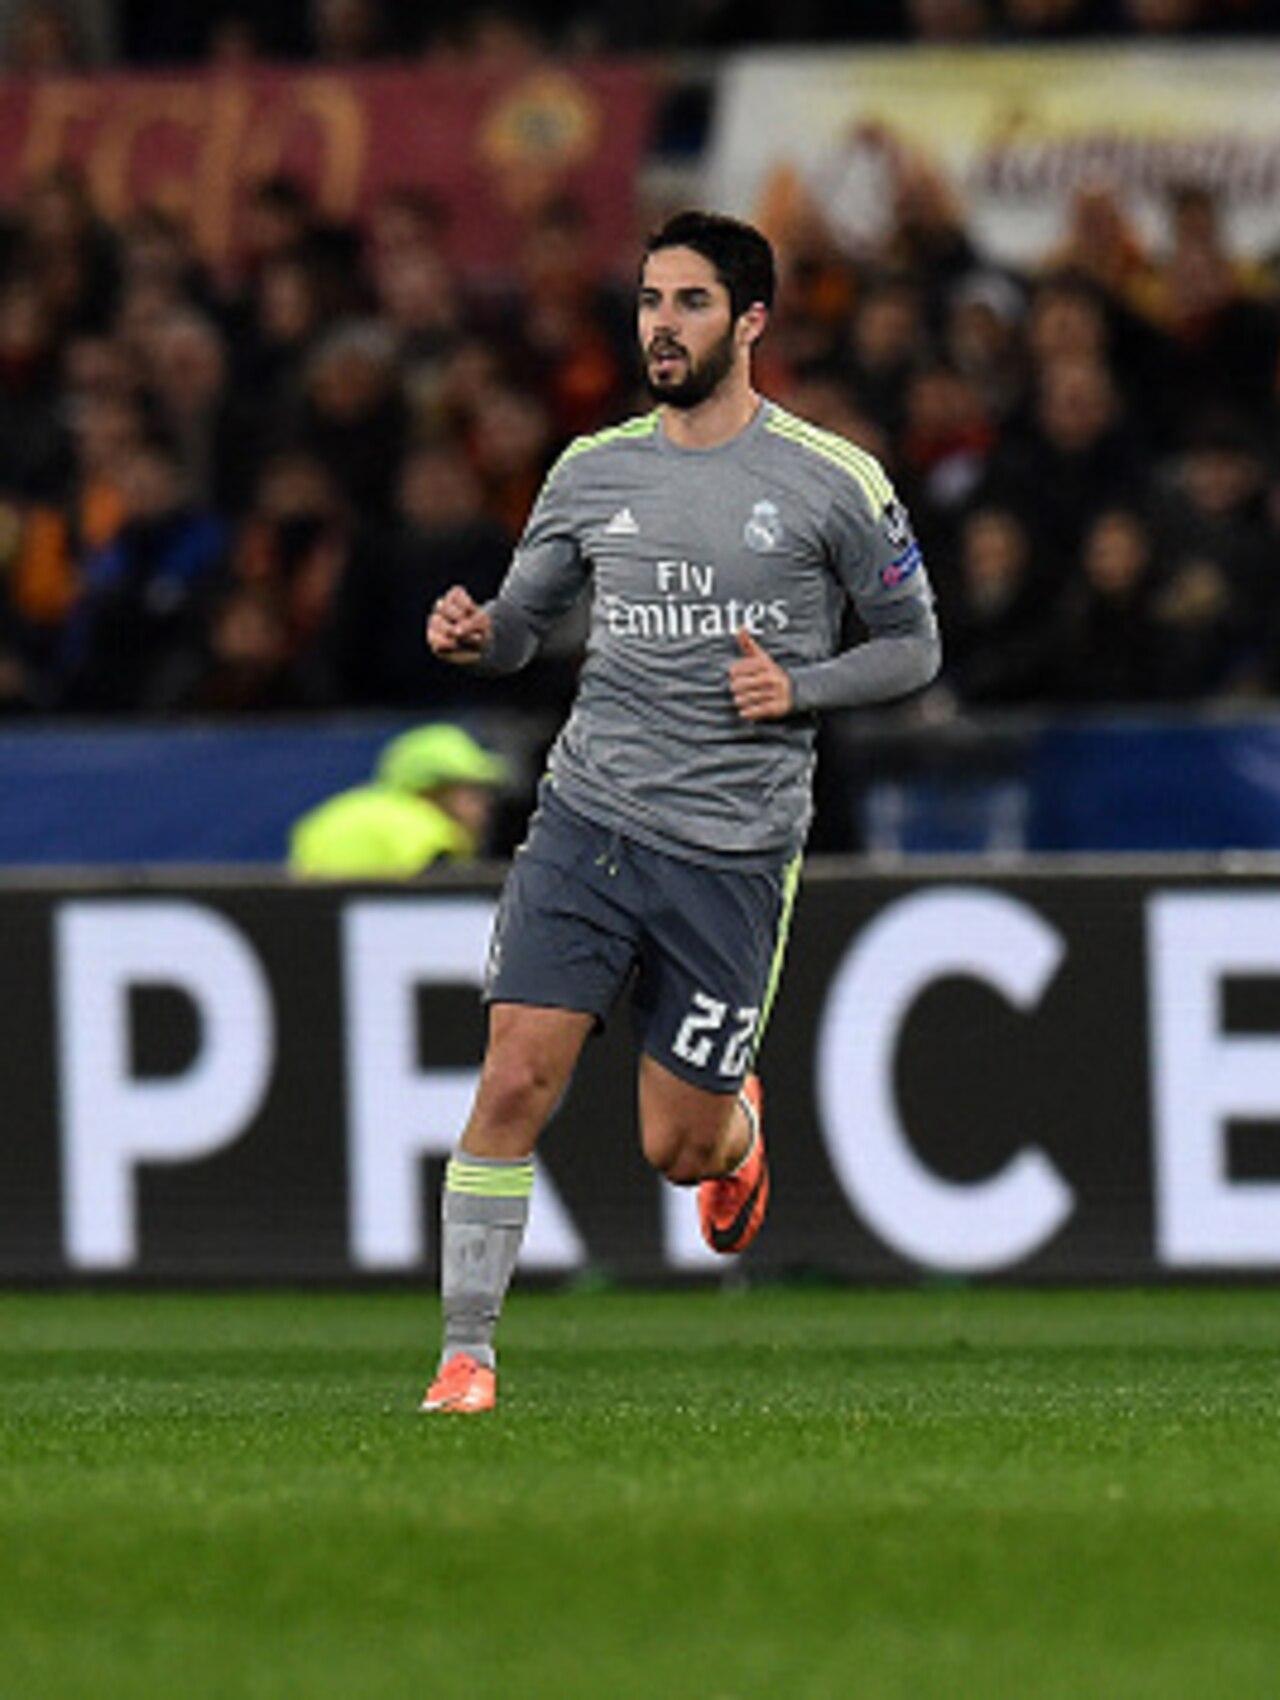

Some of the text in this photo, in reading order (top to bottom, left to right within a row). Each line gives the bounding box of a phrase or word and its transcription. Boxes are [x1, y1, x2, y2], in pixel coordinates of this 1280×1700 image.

[656, 560, 713, 597] Fly
[604, 593, 789, 638] Emirates
[671, 990, 760, 1077] 22
